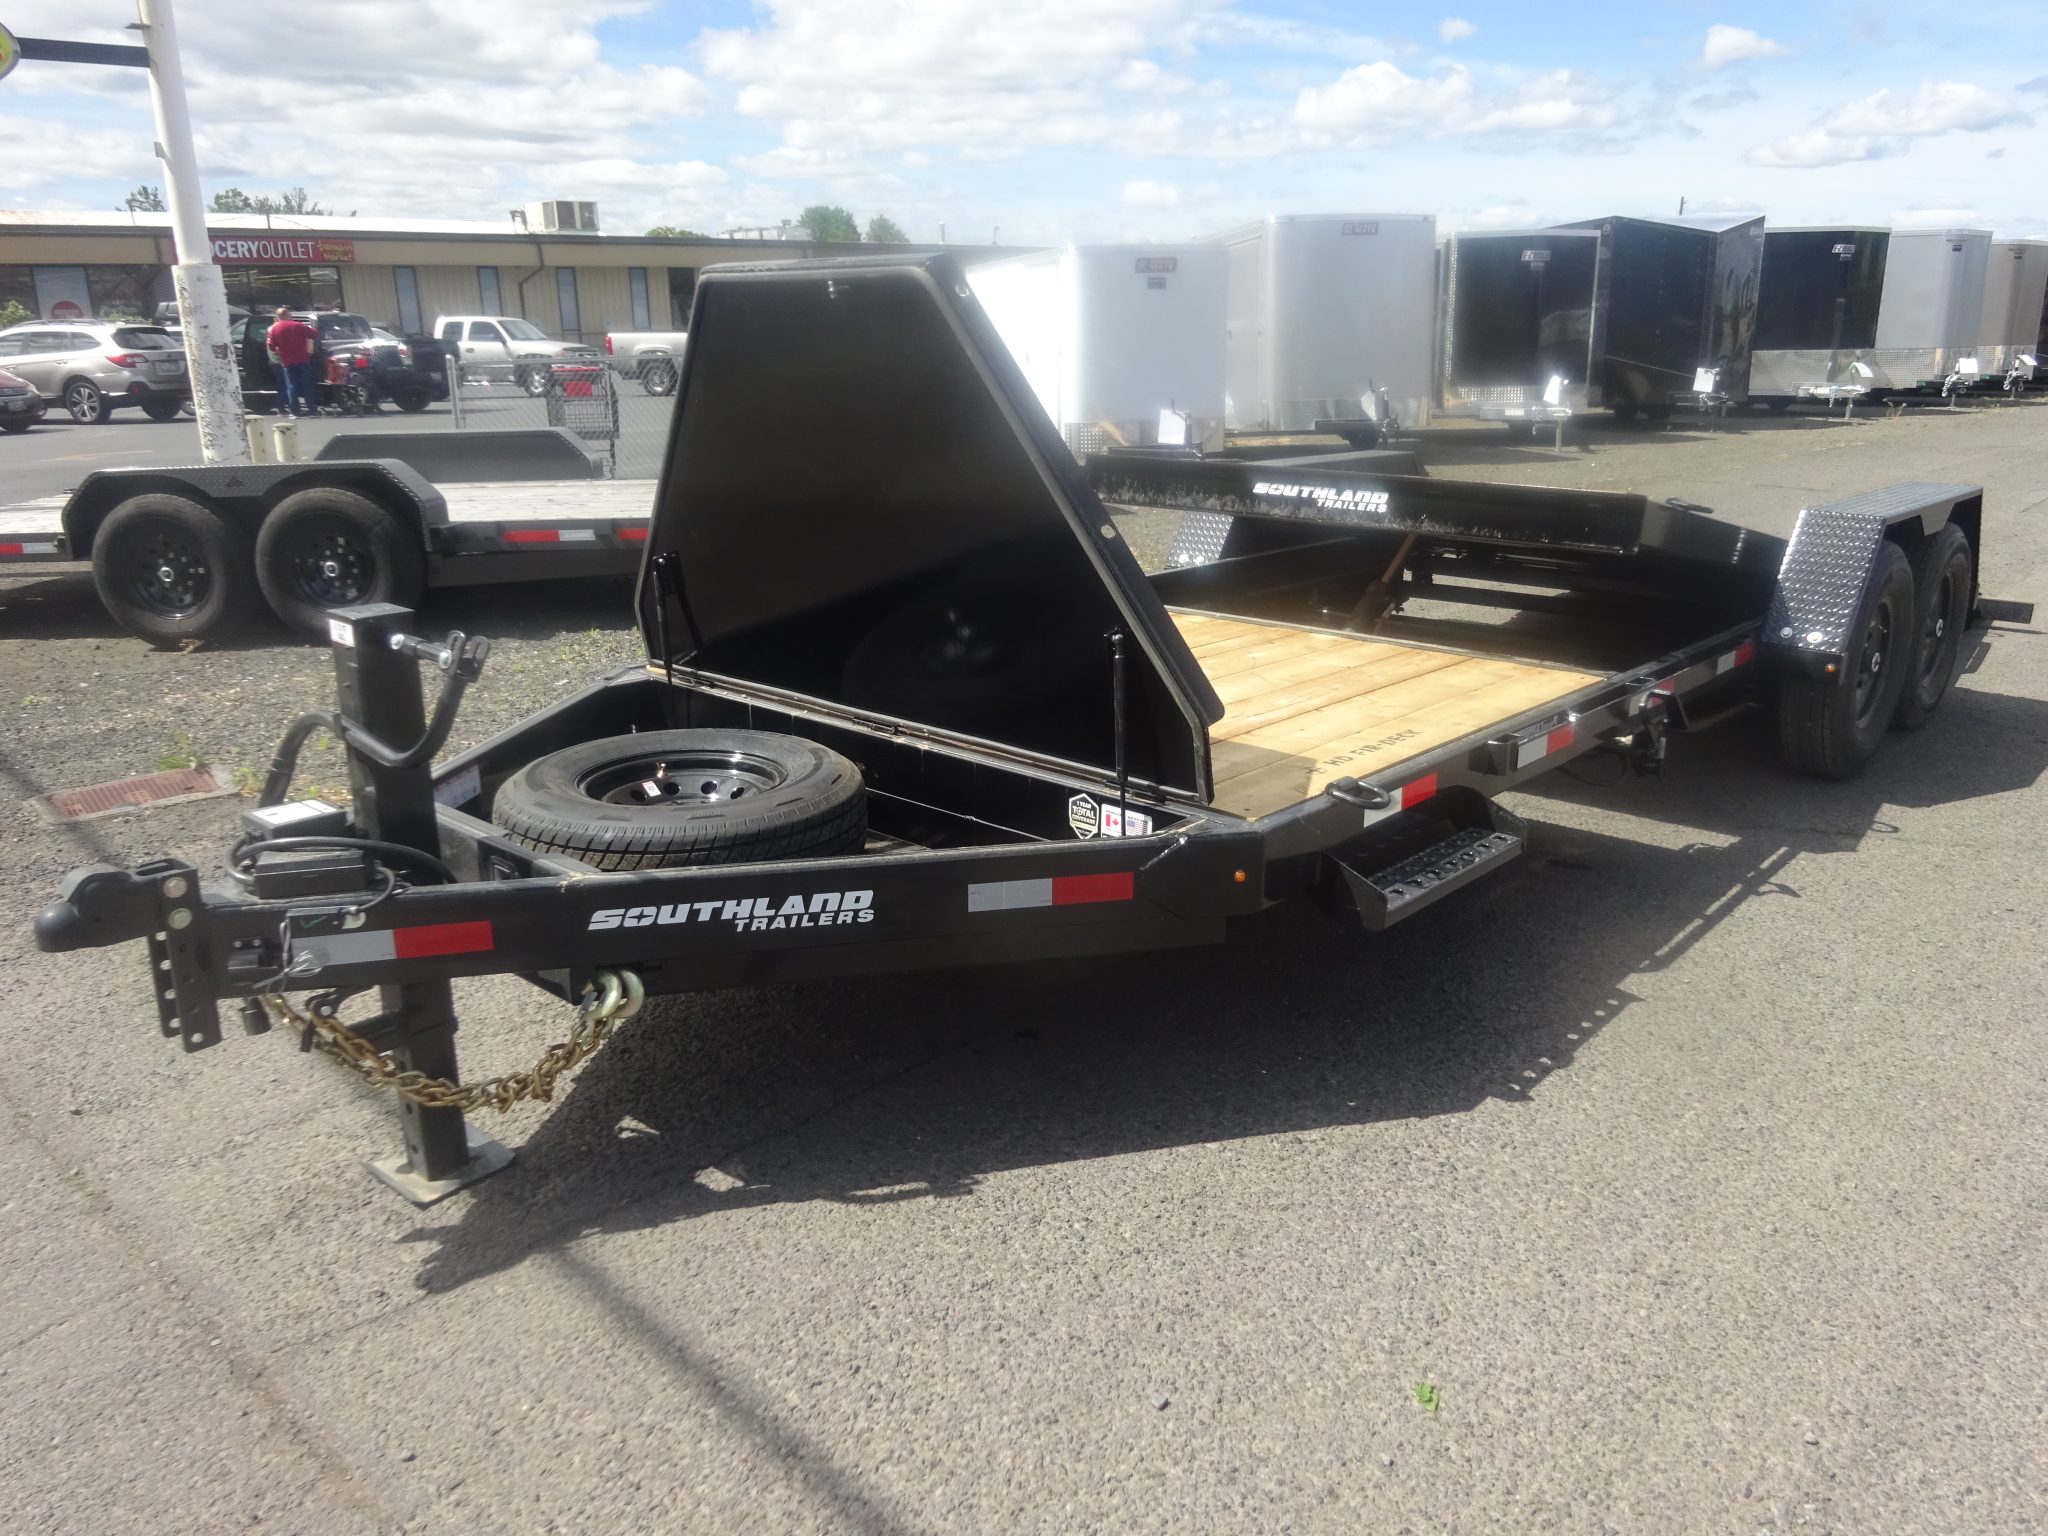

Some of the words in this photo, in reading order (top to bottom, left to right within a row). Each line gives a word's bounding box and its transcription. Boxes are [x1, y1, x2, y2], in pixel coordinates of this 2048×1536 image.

[1253, 482, 1389, 503] SOUTHLAND
[1317, 498, 1388, 513] TRAILERS
[1072, 805, 1096, 819] TOTAL
[587, 890, 874, 931] SOUTHLAND
[734, 909, 875, 933] TRAILERS
